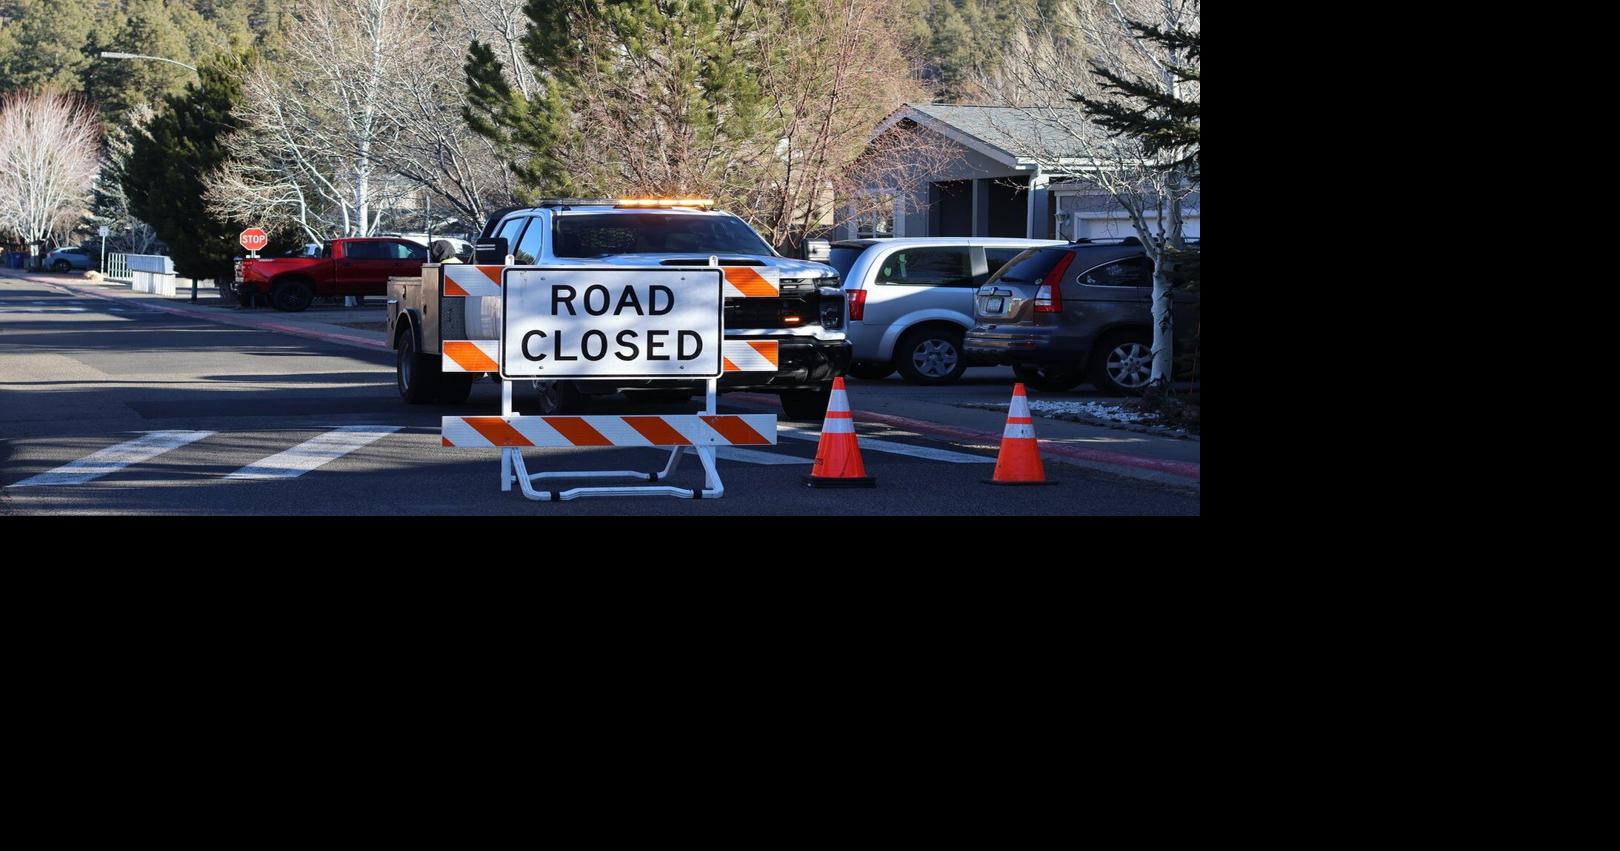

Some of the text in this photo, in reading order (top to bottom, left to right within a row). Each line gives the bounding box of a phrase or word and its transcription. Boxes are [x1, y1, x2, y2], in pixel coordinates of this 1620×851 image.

[242, 234, 266, 244] STOP
[551, 284, 675, 316] ROAD
[521, 329, 704, 362] CLOSED
